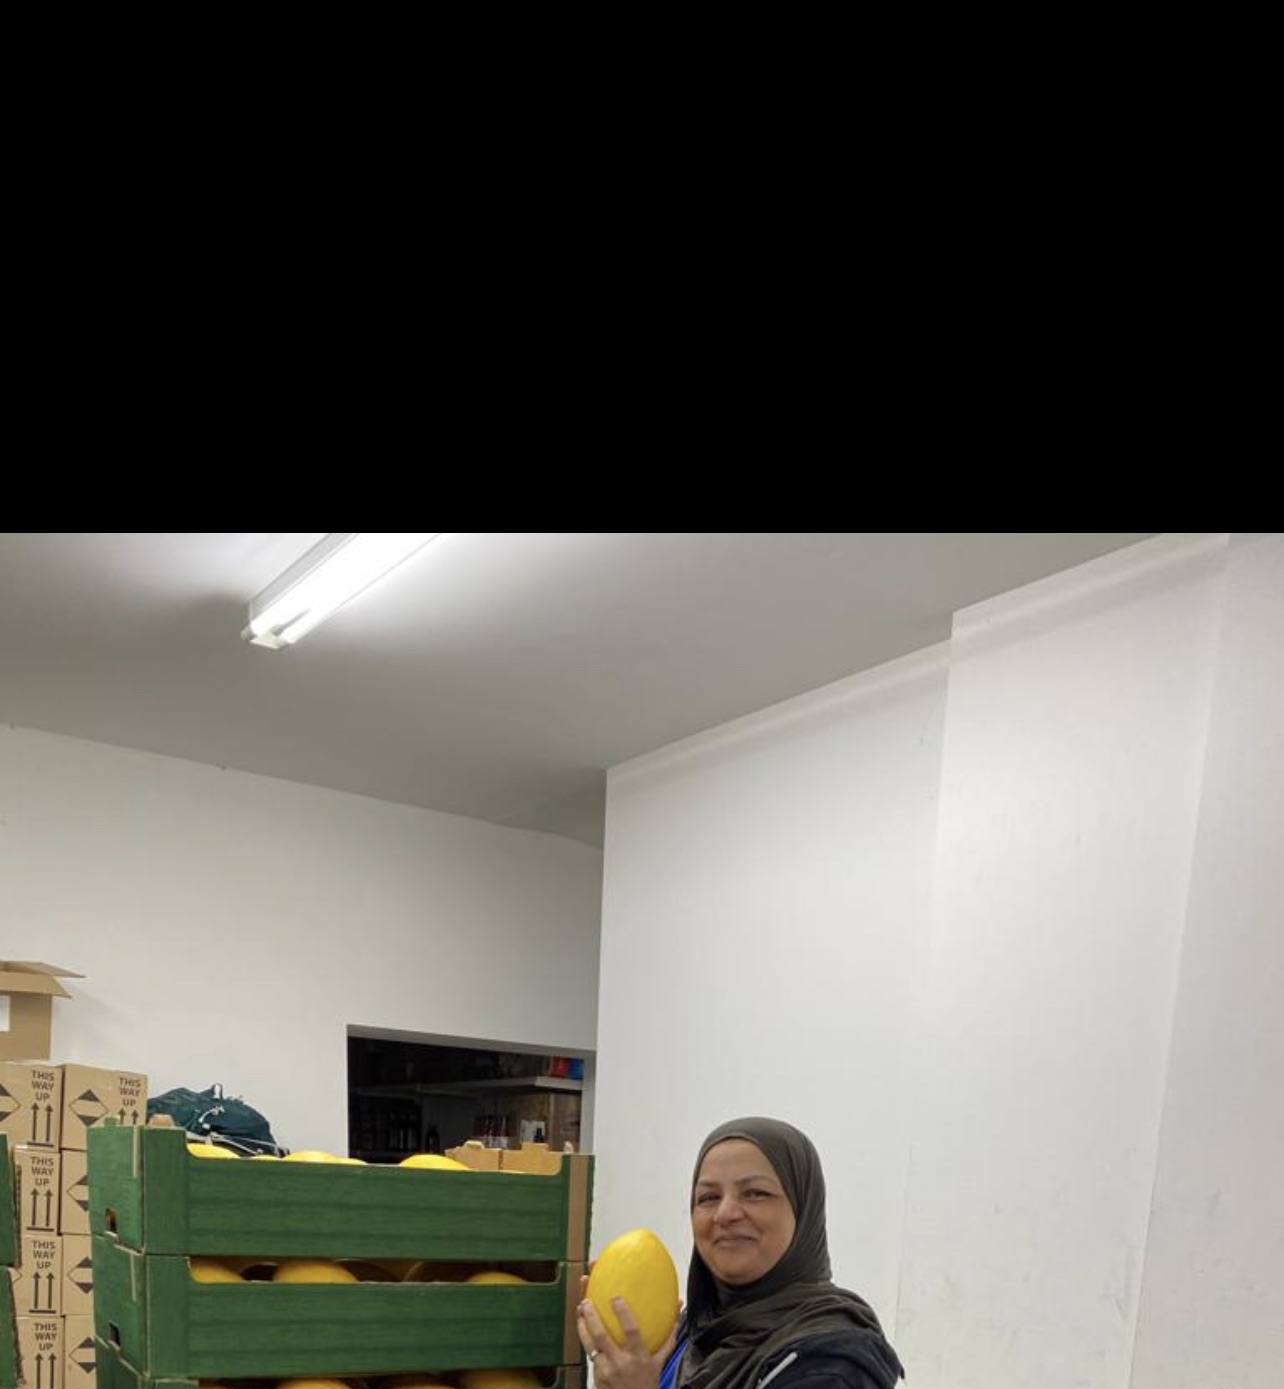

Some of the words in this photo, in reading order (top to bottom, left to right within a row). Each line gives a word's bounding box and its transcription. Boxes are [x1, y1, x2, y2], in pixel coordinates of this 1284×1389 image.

[31, 1070, 54, 1080] THIS
[32, 1081, 54, 1091] WAY
[119, 1077, 141, 1087] THIS
[119, 1087, 140, 1097] WAY
[35, 1093, 50, 1101] UP
[122, 1099, 136, 1107] UP
[31, 1156, 54, 1166] THIS
[31, 1167, 54, 1176] WAY
[35, 1178, 50, 1186] UP
[32, 1241, 55, 1249] THIS
[33, 1250, 55, 1259] WAY
[37, 1261, 51, 1269] UP
[35, 1323, 57, 1331] THIS
[35, 1332, 57, 1340] WAY
[39, 1343, 53, 1351] UP
